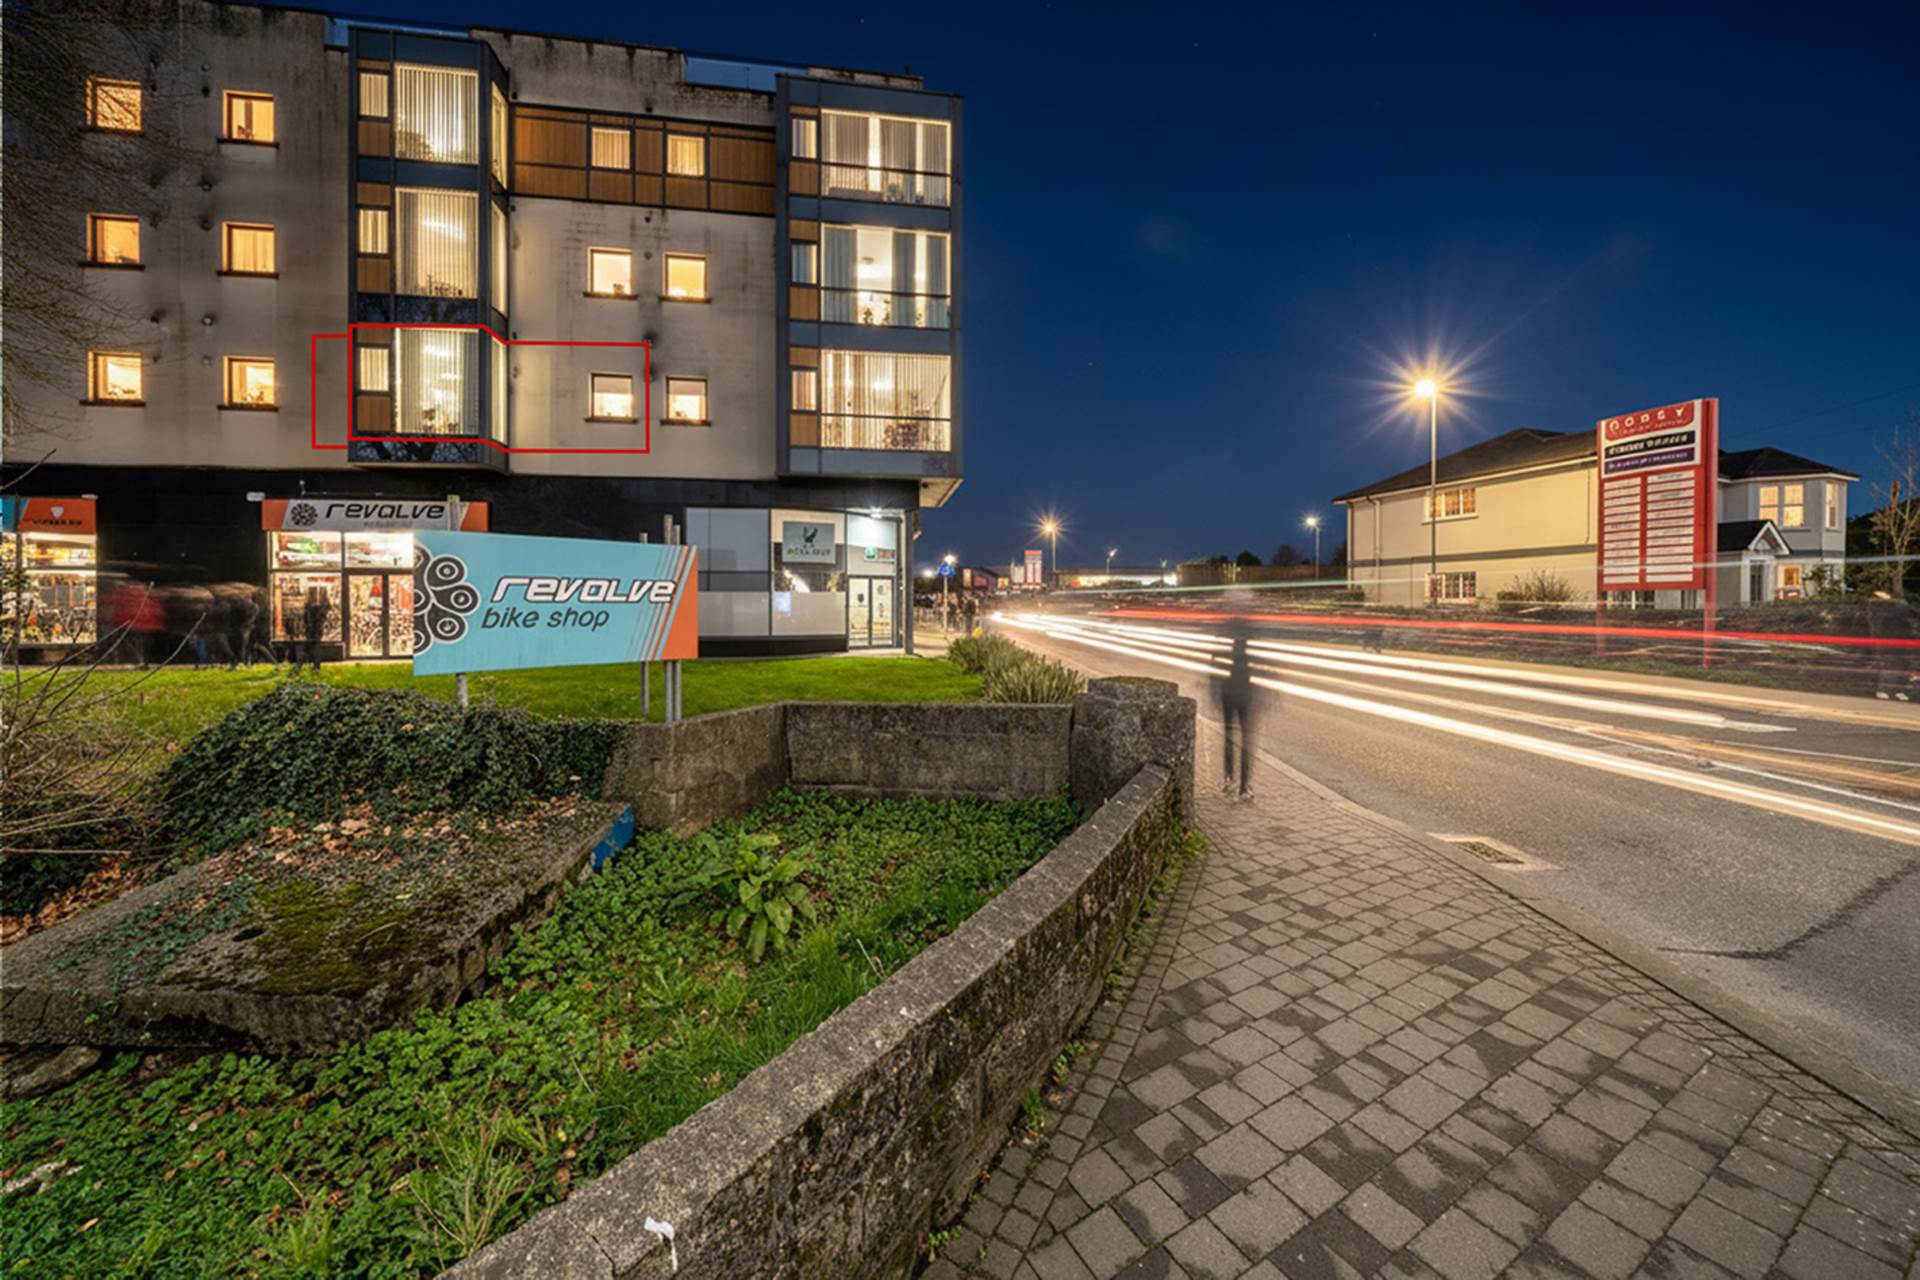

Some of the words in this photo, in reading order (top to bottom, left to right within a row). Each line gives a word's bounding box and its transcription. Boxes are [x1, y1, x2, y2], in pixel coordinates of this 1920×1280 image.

[325, 503, 445, 519] revolve
[489, 576, 677, 604] revolve
[481, 607, 539, 629] bike
[547, 607, 609, 631] shop
